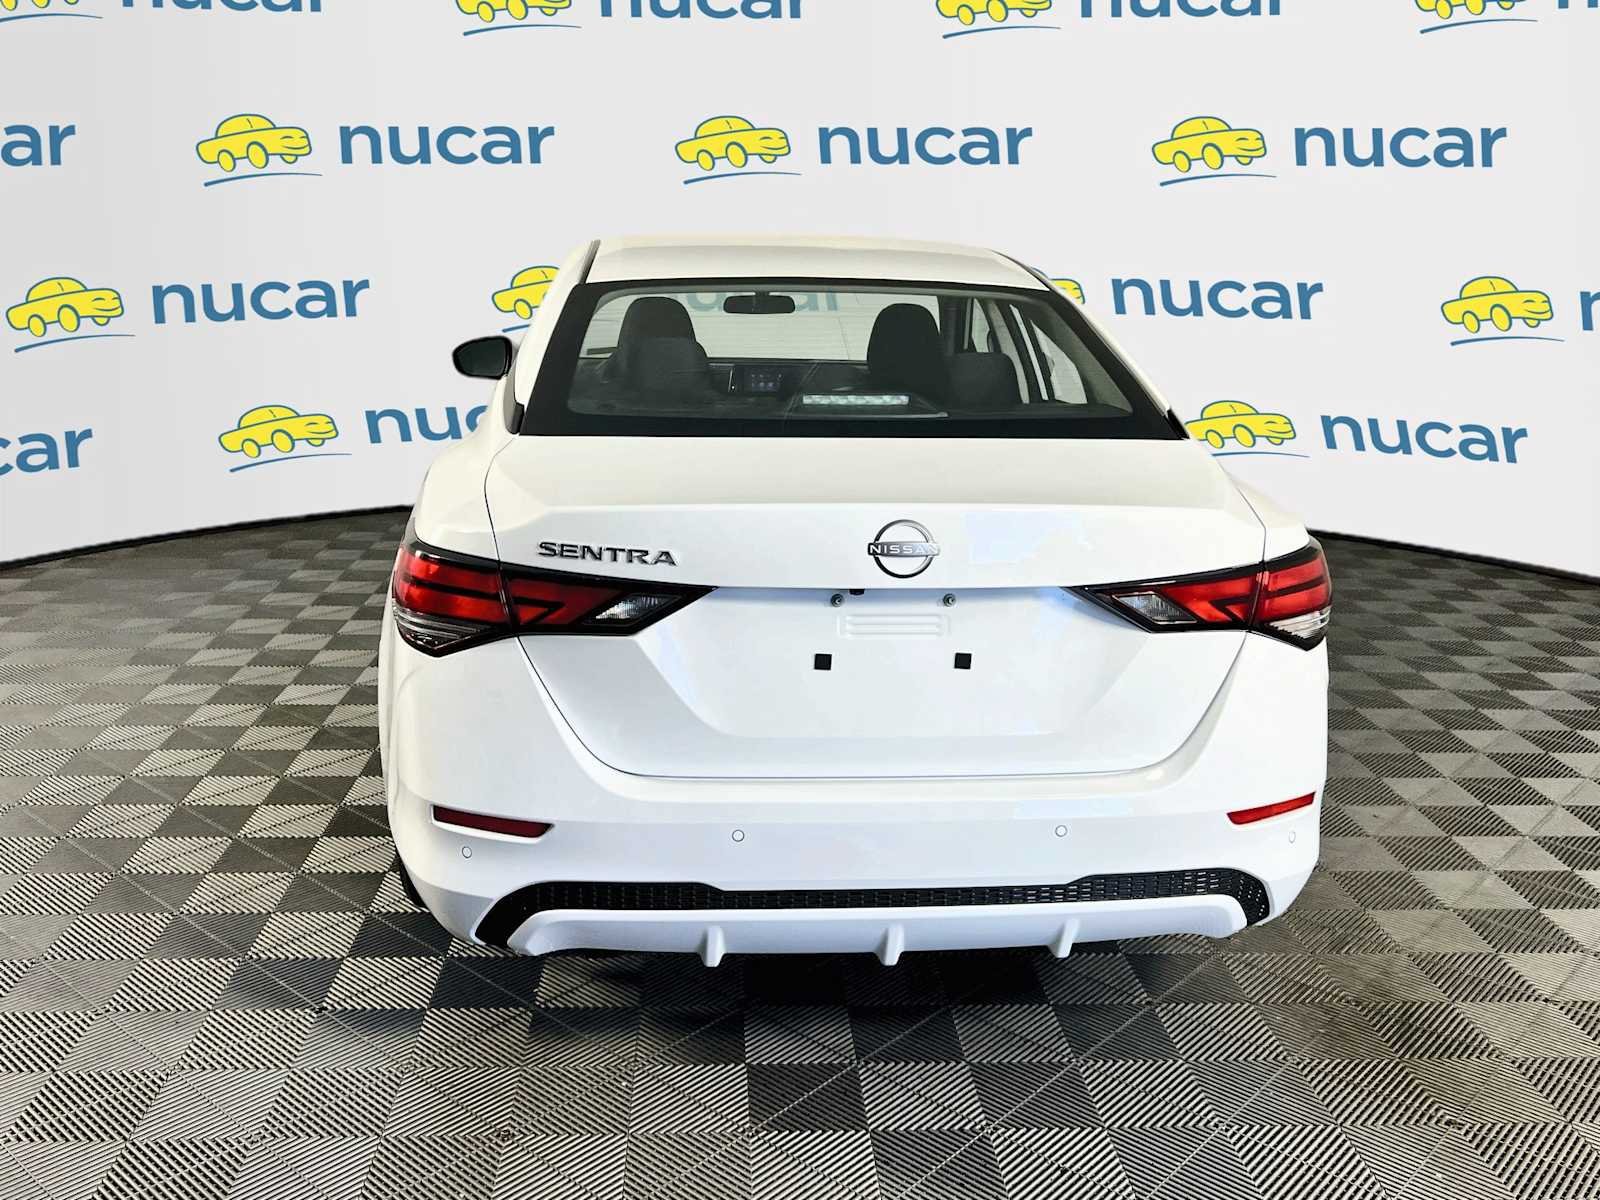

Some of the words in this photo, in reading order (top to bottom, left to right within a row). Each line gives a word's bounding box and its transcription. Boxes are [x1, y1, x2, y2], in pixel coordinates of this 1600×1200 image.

[0, 124, 76, 167] ar
[341, 125, 556, 166] nucar
[820, 128, 1033, 166] nucar
[1296, 128, 1508, 168] nucar
[153, 279, 369, 325] nucar
[1112, 278, 1324, 321] nucar
[1322, 416, 1529, 464] nucar
[537, 541, 678, 567] SENTRA
[868, 543, 939, 556] NISSAN
